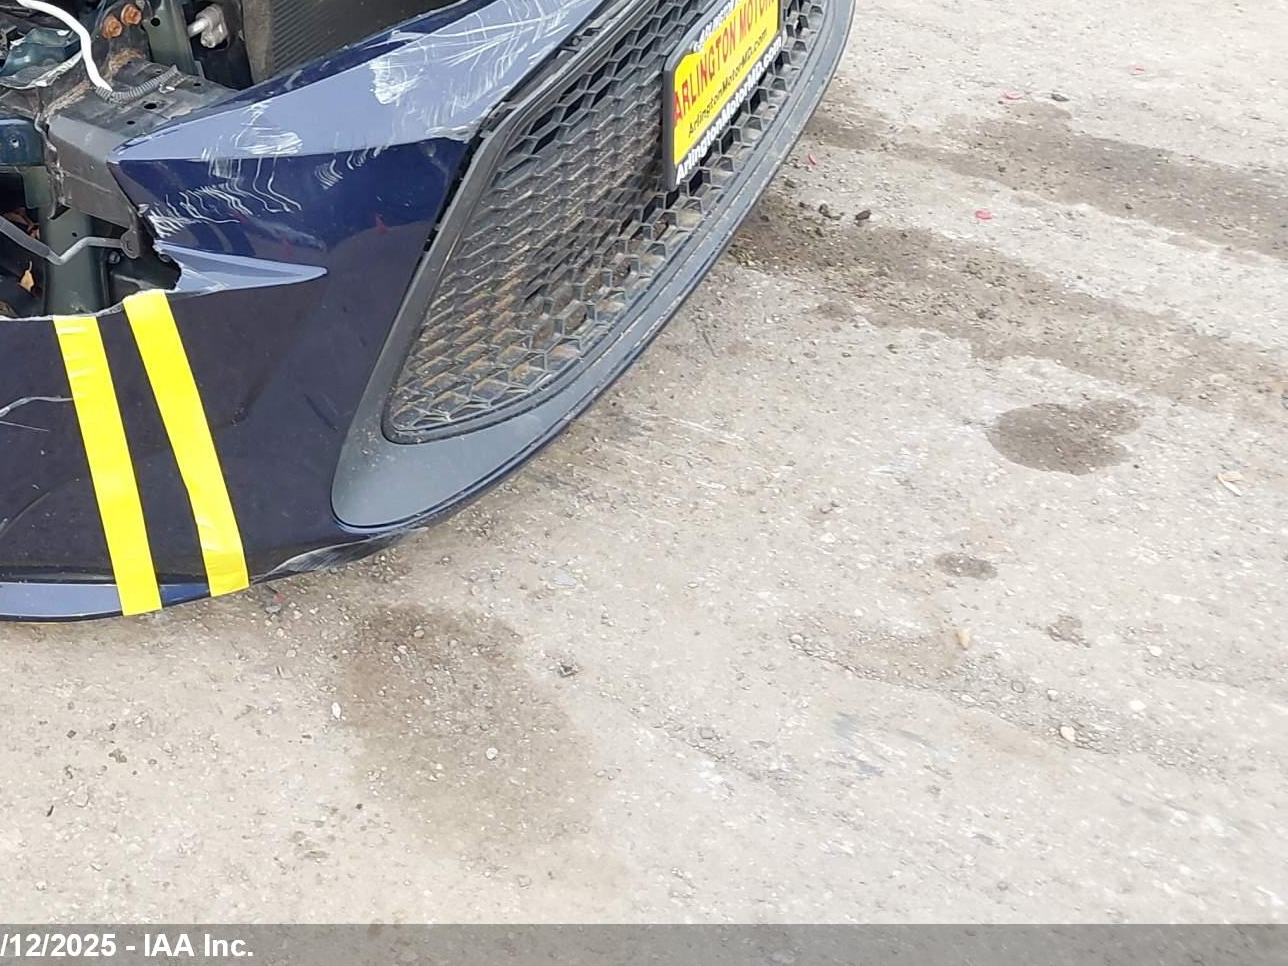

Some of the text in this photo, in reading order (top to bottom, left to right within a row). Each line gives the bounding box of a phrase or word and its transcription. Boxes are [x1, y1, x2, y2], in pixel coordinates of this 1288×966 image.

[673, 19, 736, 122] ARLINGTON
[675, 36, 782, 184] ArlingtonMotorMD.com
[688, 28, 768, 136] ArlingtonMotorMD.com
